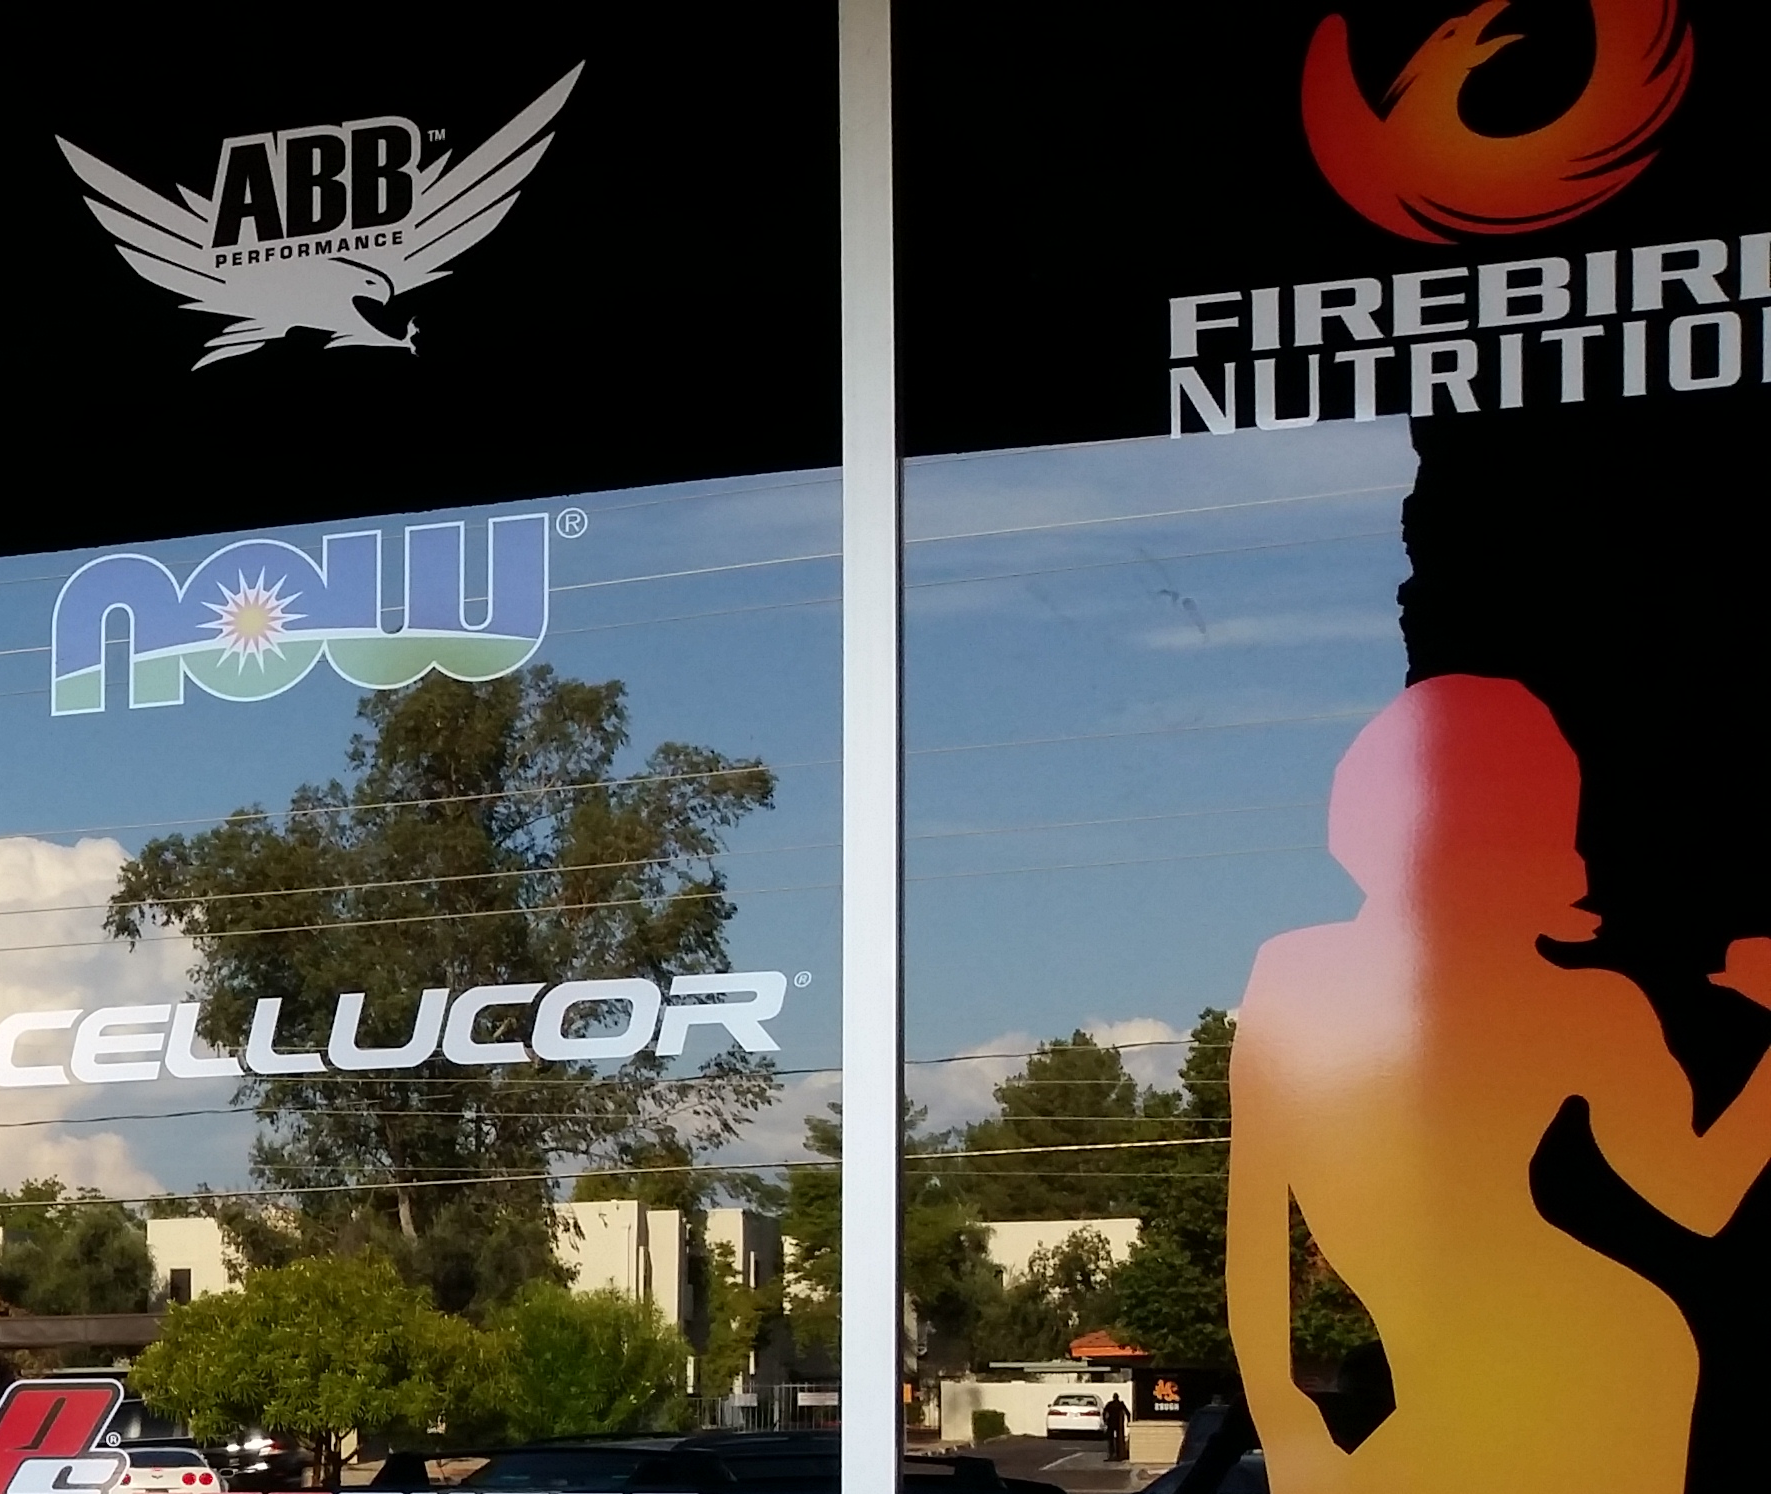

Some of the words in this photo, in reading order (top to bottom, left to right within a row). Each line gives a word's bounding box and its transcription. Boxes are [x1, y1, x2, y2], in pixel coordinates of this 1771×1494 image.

[211, 122, 415, 249] ABB
[214, 230, 405, 269] PERFORMANCE
[1168, 308, 1771, 440] NUTRITIO
